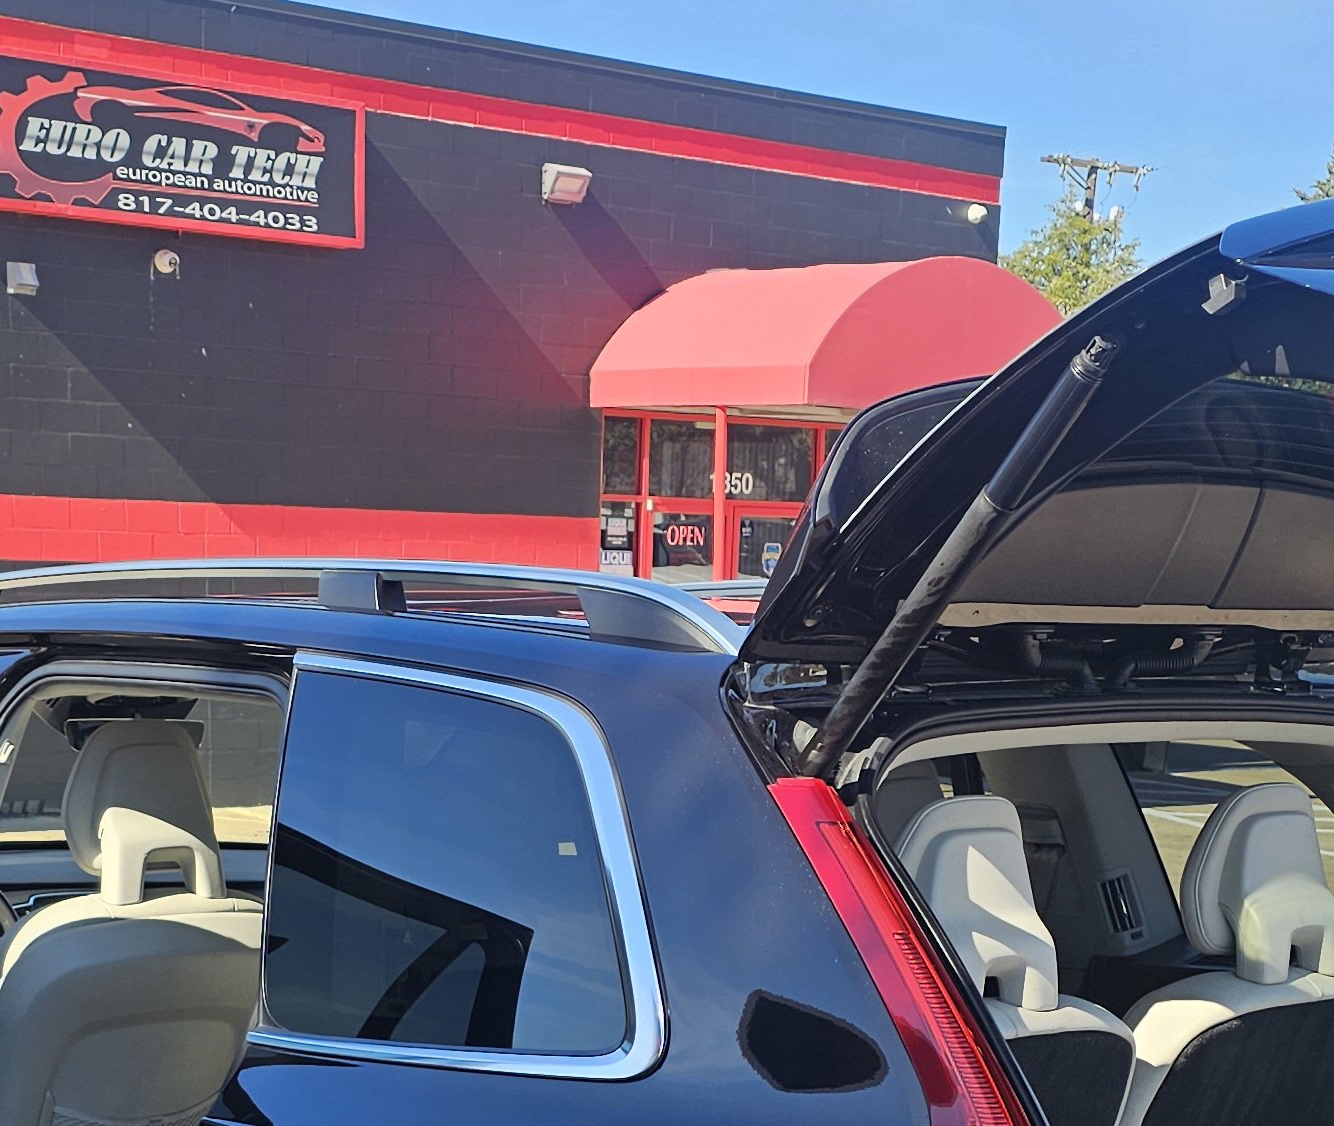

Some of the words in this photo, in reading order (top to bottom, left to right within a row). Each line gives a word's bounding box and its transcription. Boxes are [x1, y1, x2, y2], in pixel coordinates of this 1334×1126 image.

[19, 116, 130, 162] EURO
[141, 133, 218, 175] CAR
[229, 145, 324, 188] TECH
[116, 165, 208, 189] european
[212, 177, 319, 203] automotive
[116, 193, 319, 232] 817-404-4033
[666, 524, 705, 546] OPEN
